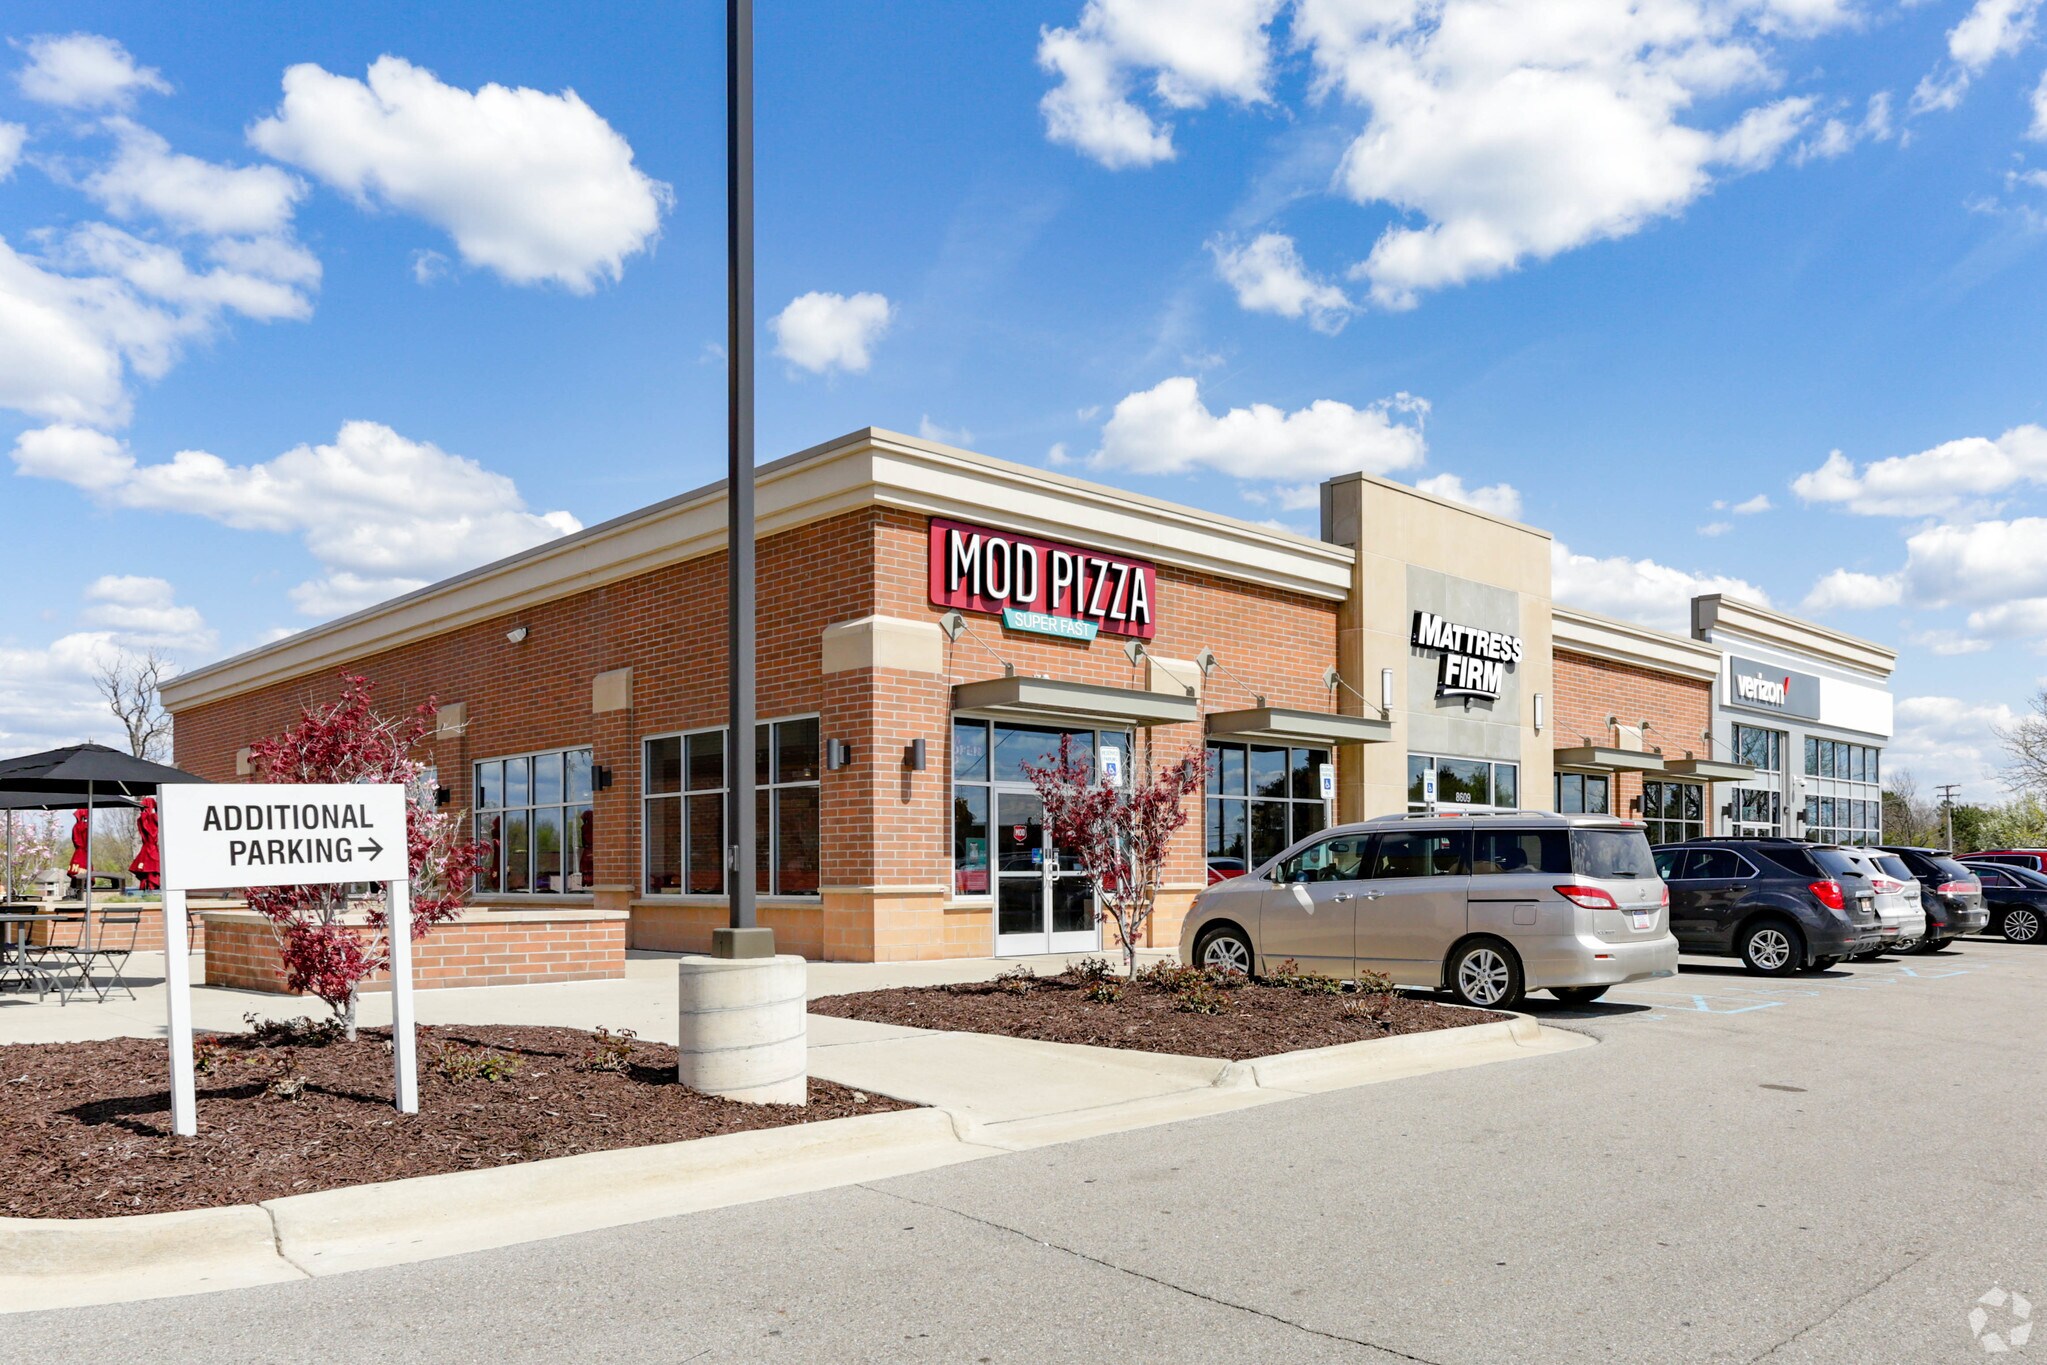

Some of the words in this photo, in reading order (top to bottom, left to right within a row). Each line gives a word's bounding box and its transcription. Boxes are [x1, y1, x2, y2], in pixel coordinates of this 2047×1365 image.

[950, 529, 1038, 604] MOD
[1052, 550, 1151, 624] PIZZA
[1014, 612, 1057, 632] SUPER
[1060, 619, 1091, 637] FAST
[1416, 611, 1523, 664] MATTRESS
[1444, 653, 1504, 694] FIRM
[1737, 672, 1785, 705] verizon
[1455, 791, 1471, 803] 8609
[203, 804, 374, 831] ADDITIONAL
[230, 837, 353, 866] PARKING
